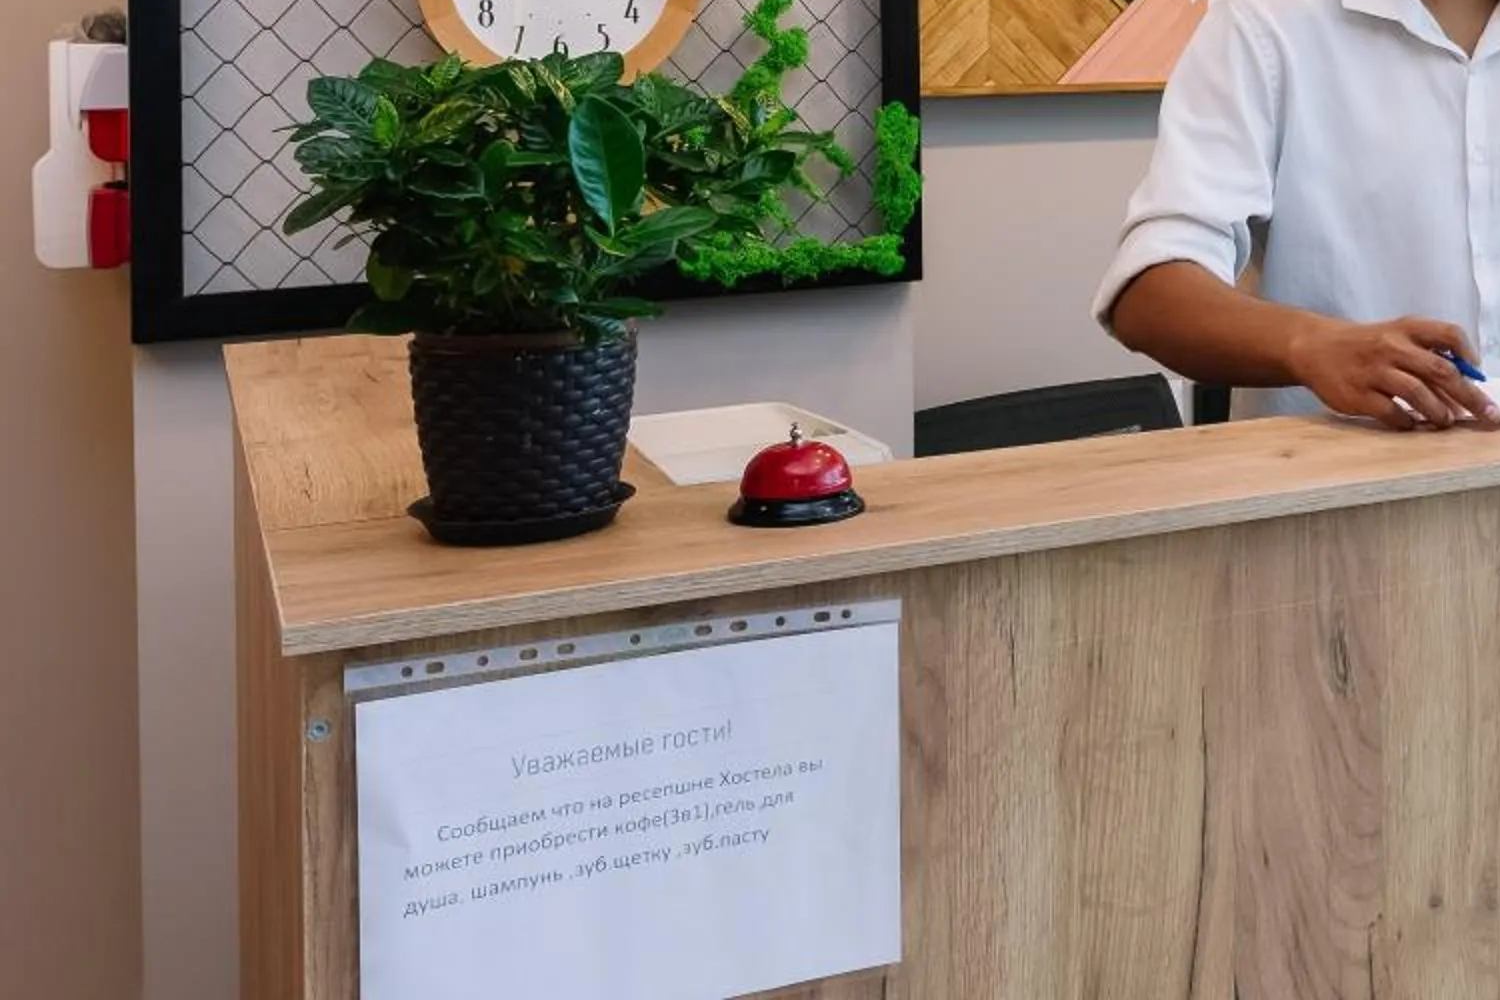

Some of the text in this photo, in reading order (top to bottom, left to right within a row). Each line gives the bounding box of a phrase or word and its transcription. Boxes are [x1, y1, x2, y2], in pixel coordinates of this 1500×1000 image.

[478, 0, 495, 29] 8
[513, 25, 525, 54] 7
[596, 23, 611, 51] 5
[511, 719, 733, 779] Уважаемые гости!
[437, 808, 547, 842] Сообщаем
[551, 800, 584, 817] что
[589, 795, 613, 810] на
[719, 762, 792, 787] Хостела
[798, 759, 824, 774] вы
[403, 850, 483, 881] можете
[489, 824, 608, 862] приобрести
[760, 791, 794, 811] для
[471, 871, 563, 900] шампунь
